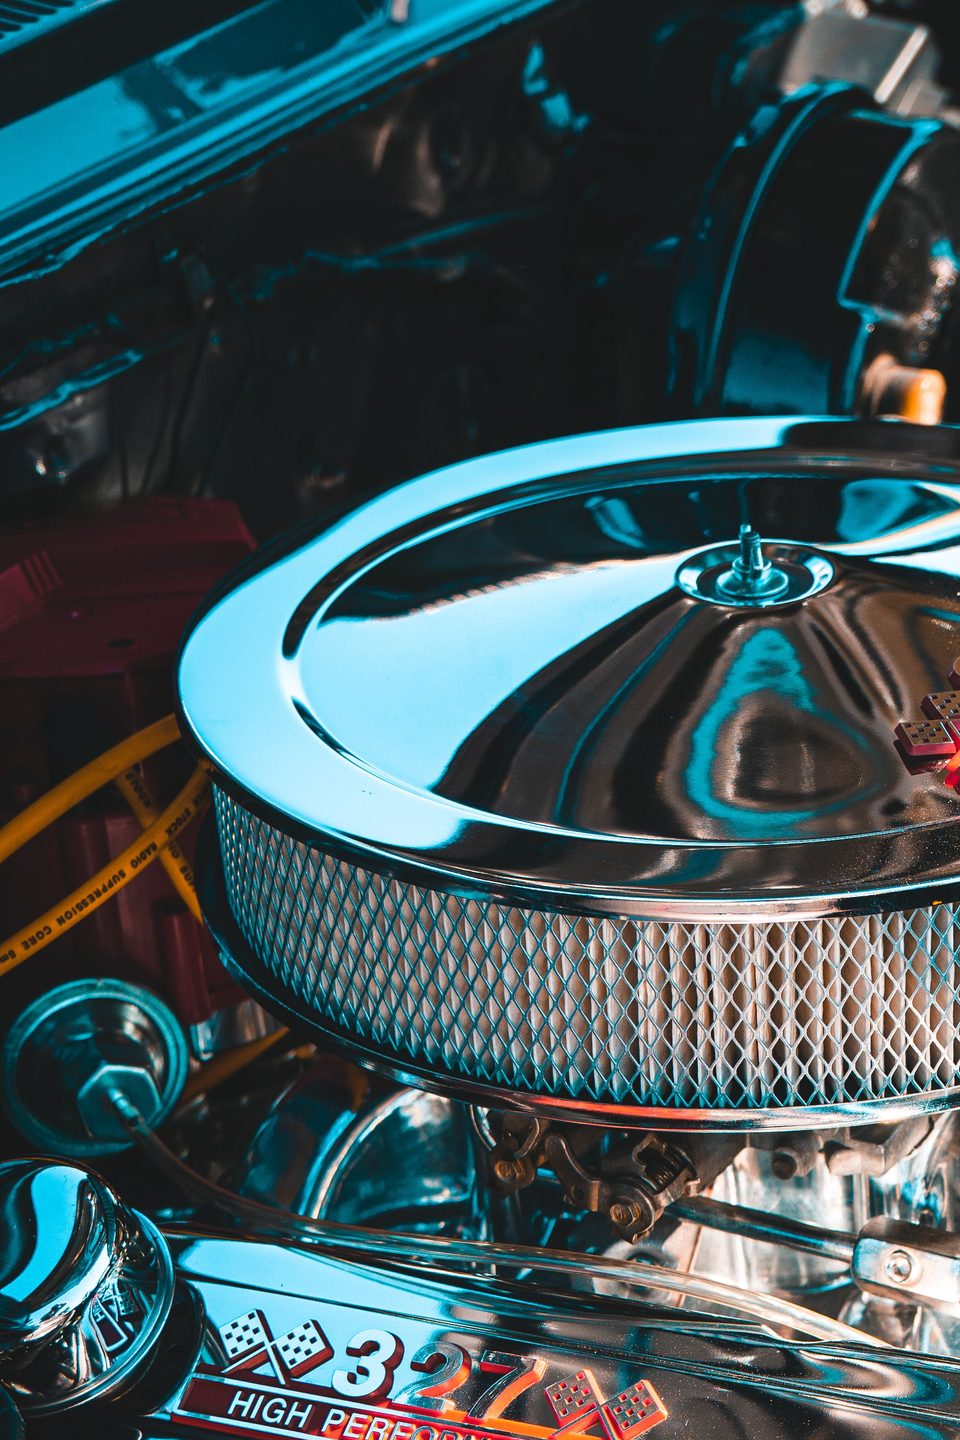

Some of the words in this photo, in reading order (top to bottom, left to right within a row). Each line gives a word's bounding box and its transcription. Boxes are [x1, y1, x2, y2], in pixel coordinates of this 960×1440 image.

[165, 808, 192, 836] STOCK
[130, 842, 158, 869] RADIO
[56, 869, 126, 927] SUPPRESSION
[22, 926, 52, 950] CORE
[331, 1328, 548, 1424] 327
[227, 1389, 313, 1430] HIGH
